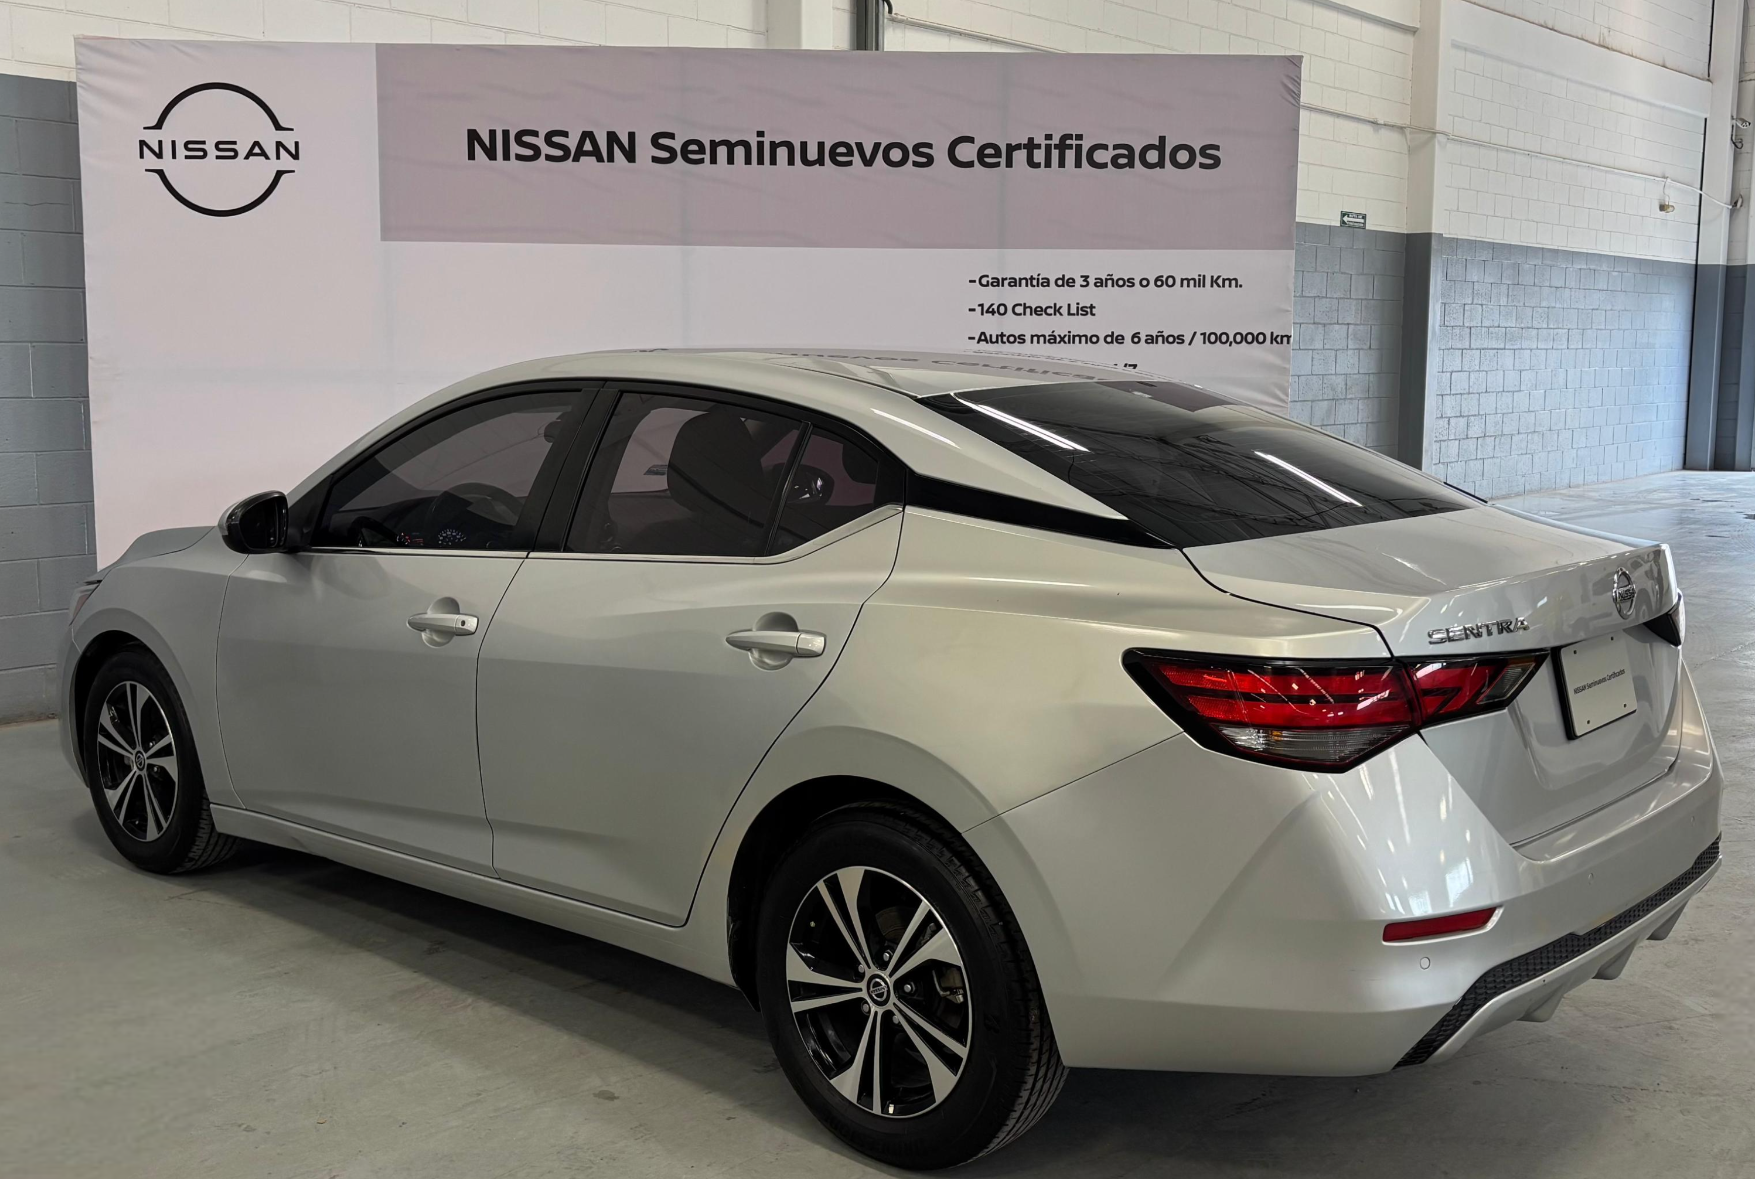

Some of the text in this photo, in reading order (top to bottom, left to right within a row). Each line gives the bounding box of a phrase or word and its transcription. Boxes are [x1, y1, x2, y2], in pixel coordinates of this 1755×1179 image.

[138, 139, 300, 161] NISSAN
[466, 128, 1222, 170] NISSAN Seminuevos Certificados
[968, 272, 1243, 289] -Garantía de 3 años o 60 mil Km.
[968, 301, 1097, 317] -140 Check List
[967, 330, 1027, 346] -Autos
[1029, 329, 1100, 346] máximo
[1103, 330, 1126, 346] de
[1130, 331, 1142, 346] 6
[1144, 330, 1186, 346] años
[1200, 331, 1267, 348] 100,000
[1427, 616, 1530, 645] SENTRA
[1573, 668, 1626, 696] NISSAN Seminuevos Certificados
